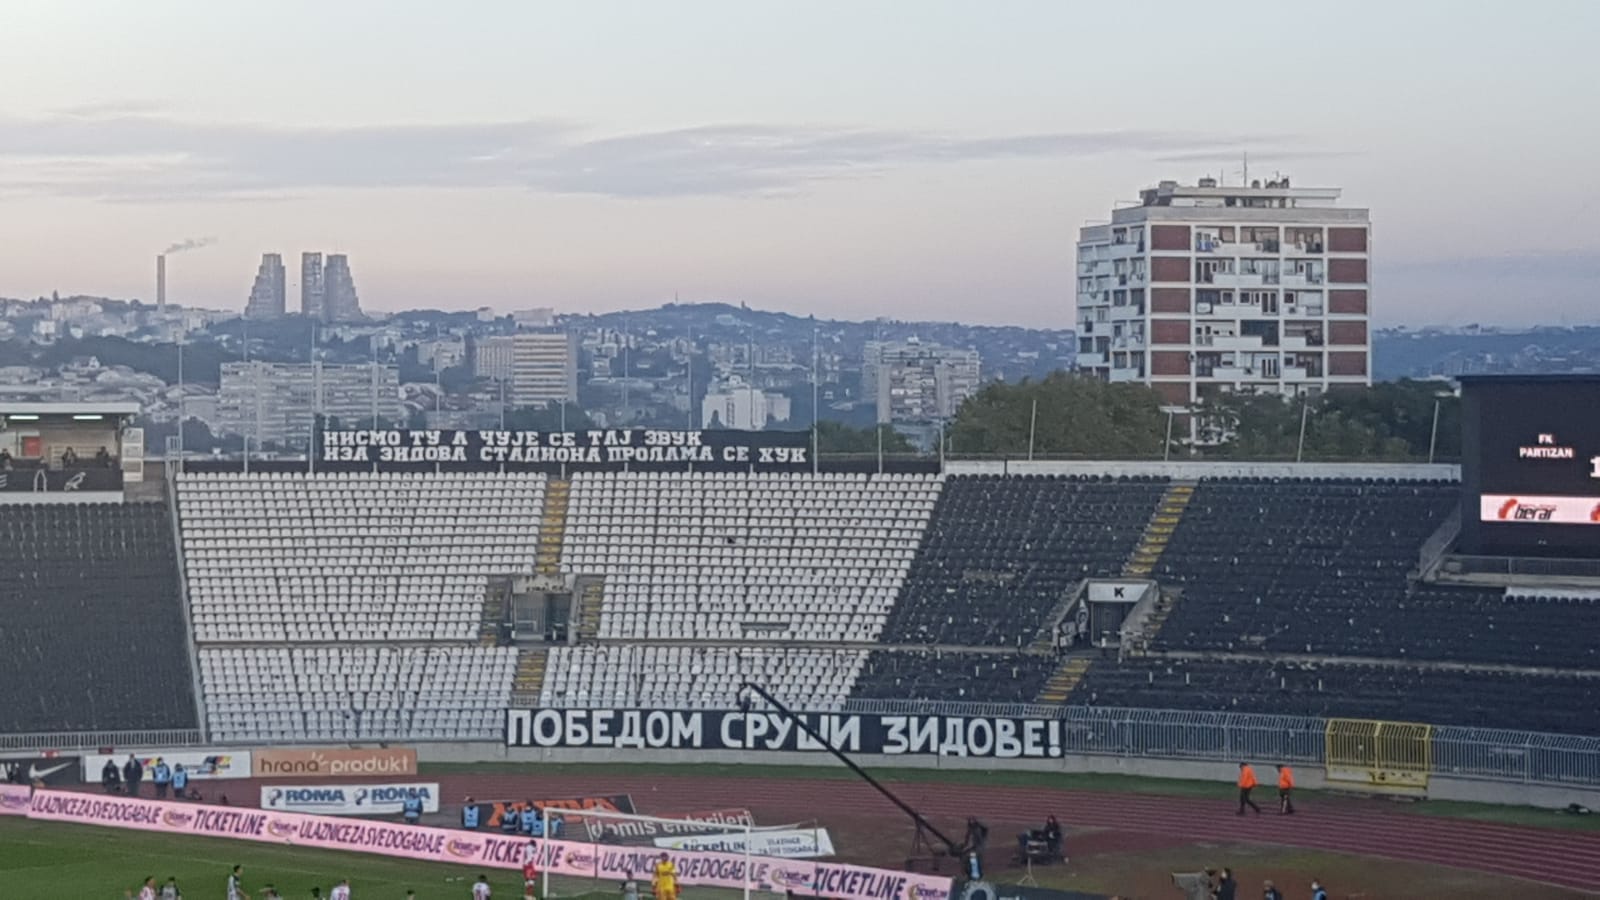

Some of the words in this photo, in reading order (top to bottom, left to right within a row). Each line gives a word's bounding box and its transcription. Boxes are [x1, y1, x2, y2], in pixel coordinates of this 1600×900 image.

[323, 431, 400, 446] НИСМО
[410, 431, 440, 445] ТУ
[479, 431, 538, 446] ЧУЈЕ
[549, 432, 575, 446] СЕ
[588, 430, 631, 446] ТАЈ
[644, 431, 702, 446] ЗВУК
[1538, 434, 1553, 444] FK
[480, 446, 600, 462] СТАДИОНА
[607, 446, 713, 462] ПРОЛАМА
[723, 447, 749, 461] СЕ
[759, 447, 806, 463] ХУК
[1519, 447, 1573, 458] PARTIZAN
[508, 709, 702, 749] ПОБЕДОМ
[881, 715, 1062, 758] ЗИДОВЕ!
[261, 758, 319, 773] hrana
[331, 755, 409, 775] produkt
[285, 788, 345, 802] ROMA
[193, 809, 267, 835] TICKETLINE
[812, 866, 907, 900] TICKETLINE
